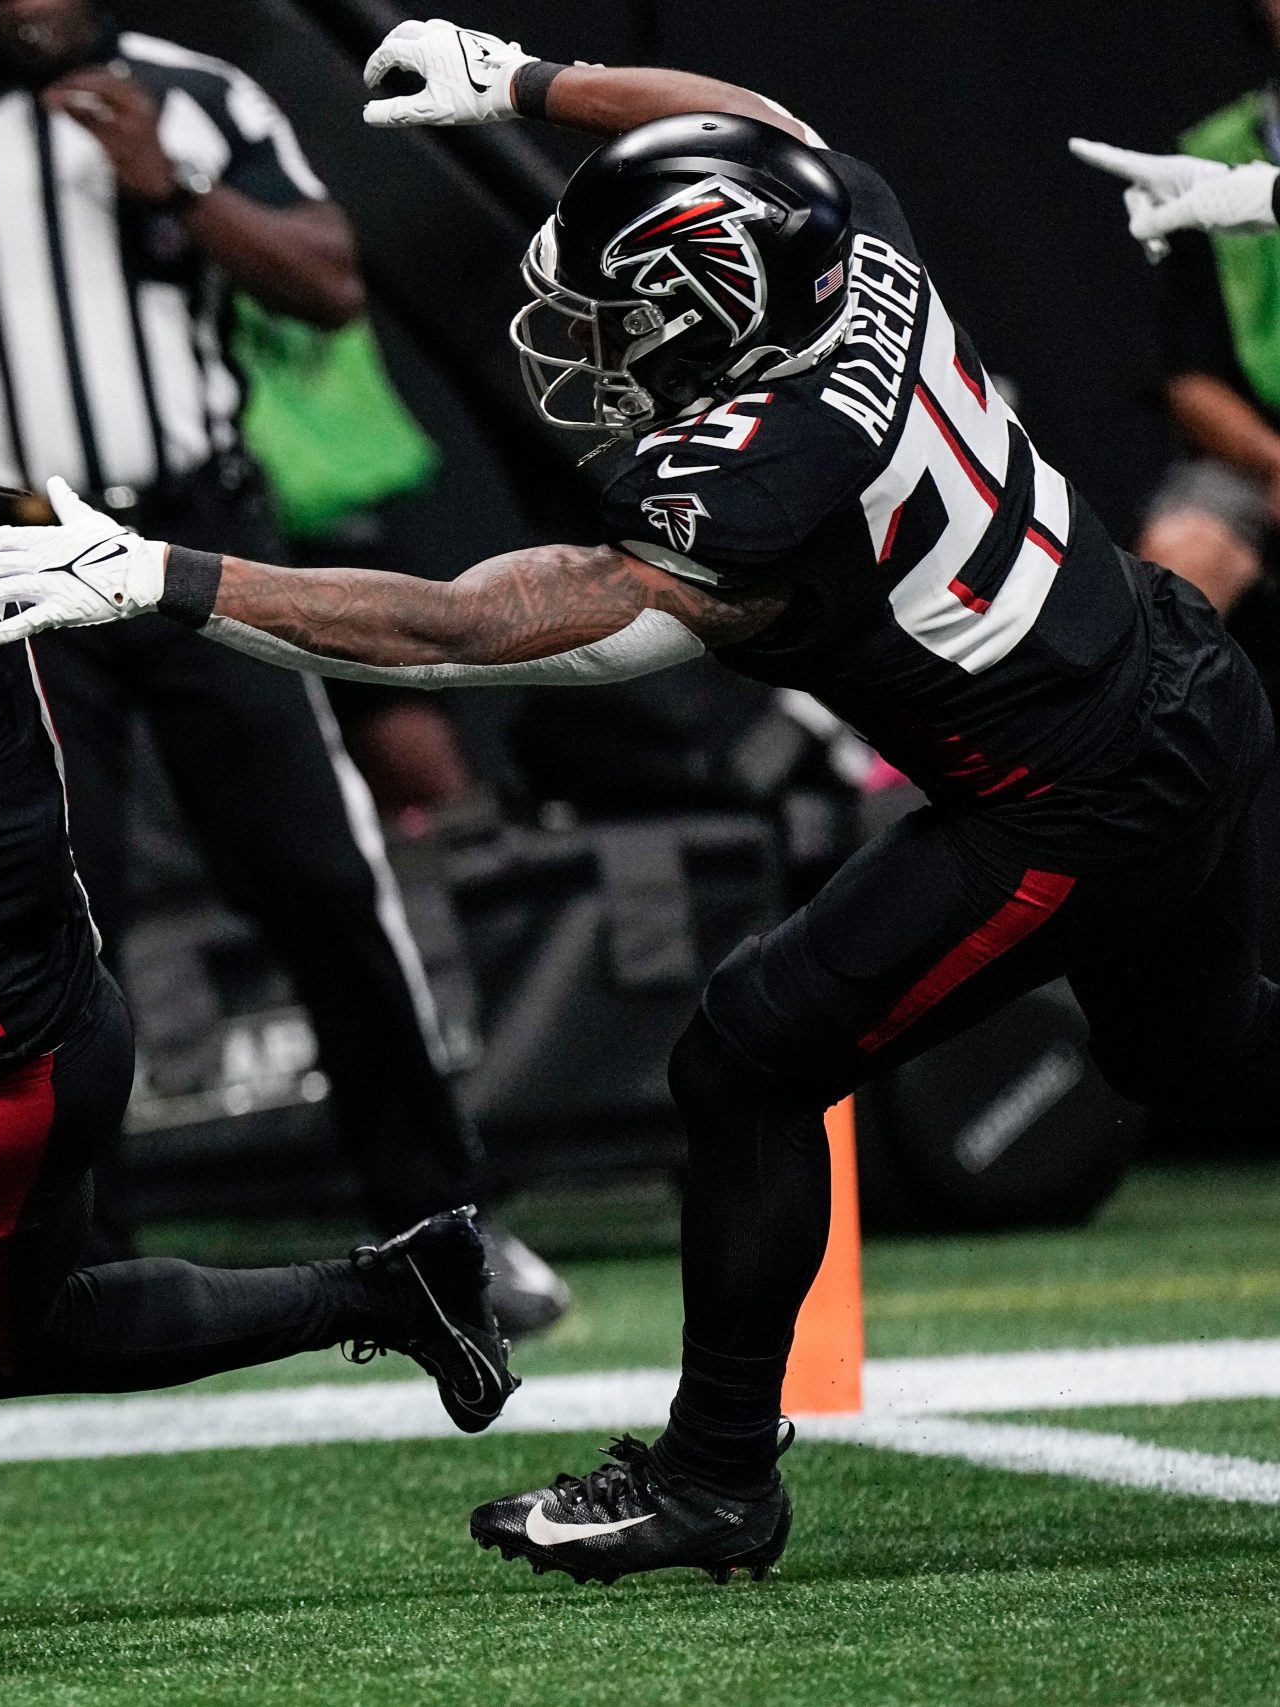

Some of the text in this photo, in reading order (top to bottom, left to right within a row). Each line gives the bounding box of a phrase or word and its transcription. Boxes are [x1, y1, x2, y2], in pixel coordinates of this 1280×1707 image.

[820, 233, 921, 447] ALLGEIER
[635, 392, 776, 456] 25
[860, 265, 1071, 675] 25
[714, 1507, 744, 1526] VAPOR
